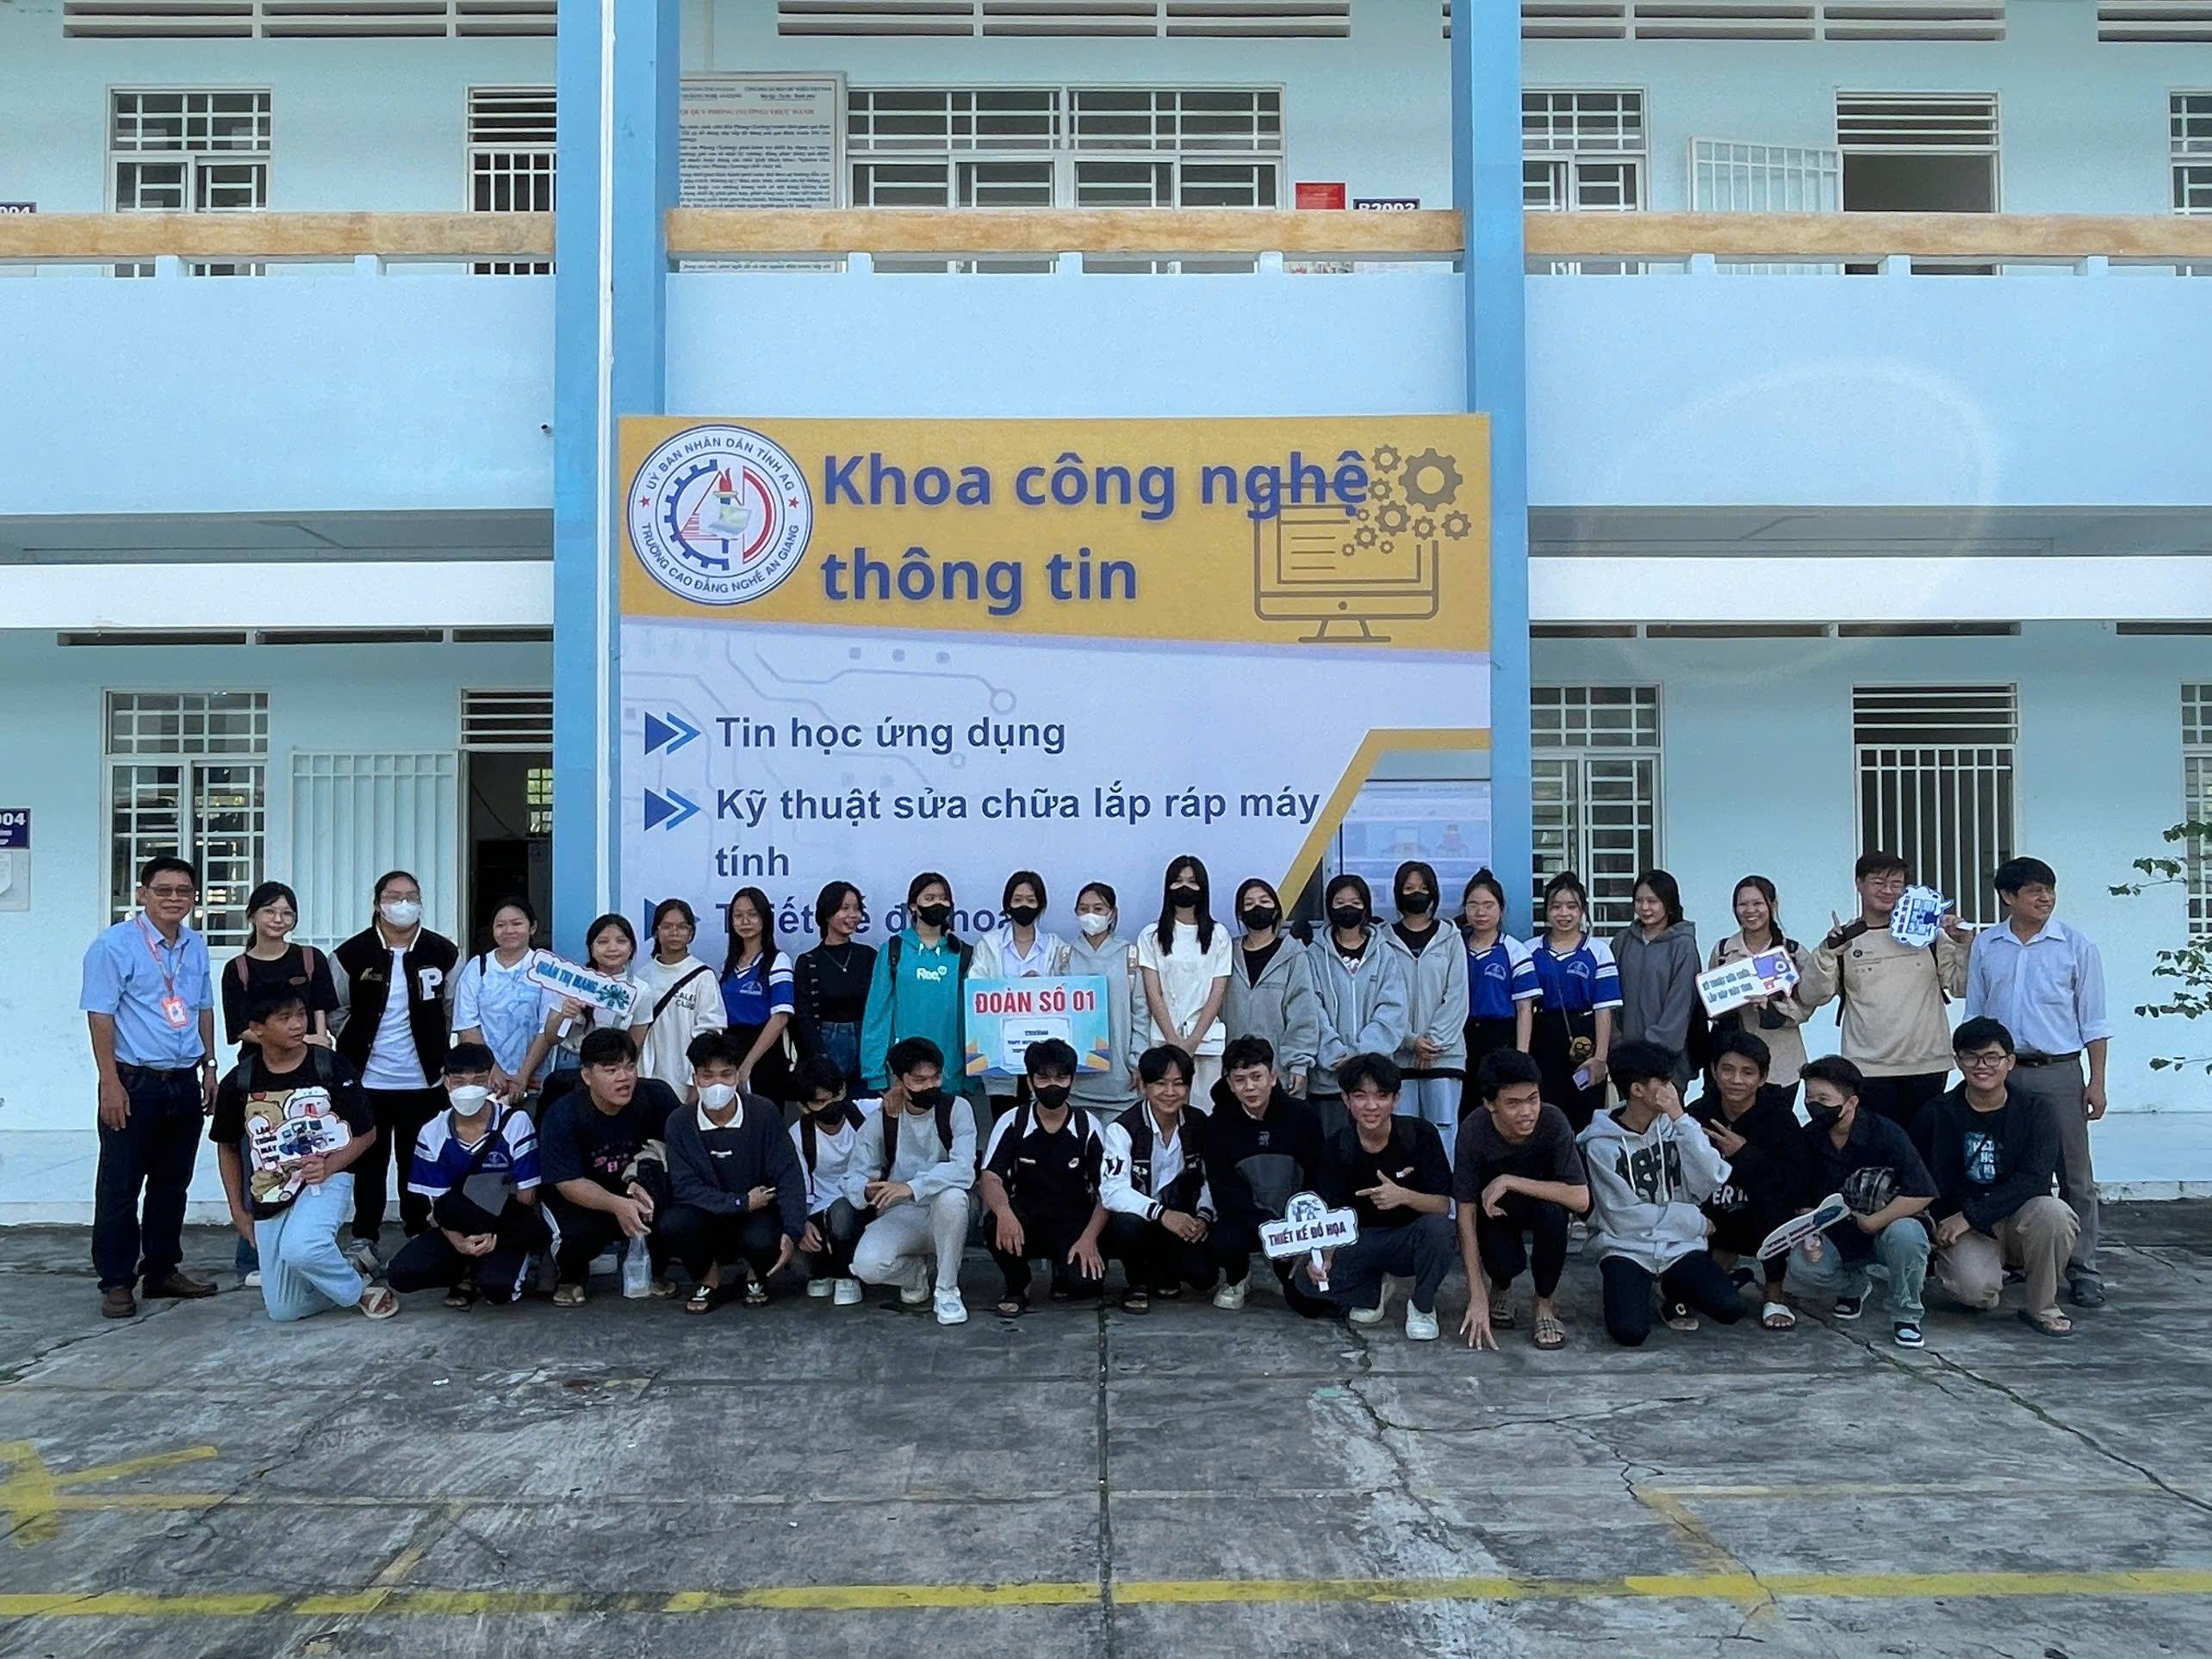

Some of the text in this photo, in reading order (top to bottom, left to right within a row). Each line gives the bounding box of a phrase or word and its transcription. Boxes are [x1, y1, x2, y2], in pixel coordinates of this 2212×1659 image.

[659, 450, 684, 472] BAN
[685, 436, 722, 454] NHÂN
[780, 472, 795, 492] AG
[824, 450, 1369, 520] Khoa công nghệ
[668, 567, 693, 587] CAO
[766, 561, 781, 576] AN
[778, 525, 799, 561] GIANG
[821, 547, 1137, 616] thông tin
[716, 716, 1066, 755] Tin học ứng dụng
[0, 812, 26, 826] 04
[718, 780, 1320, 827] Kỹ thuật sửa chữa lắp ráp máy
[715, 845, 789, 876] tính
[716, 896, 814, 933] Tết
[418, 966, 443, 1001] P
[975, 982, 1094, 1014] ĐOÀN SỐ 01
